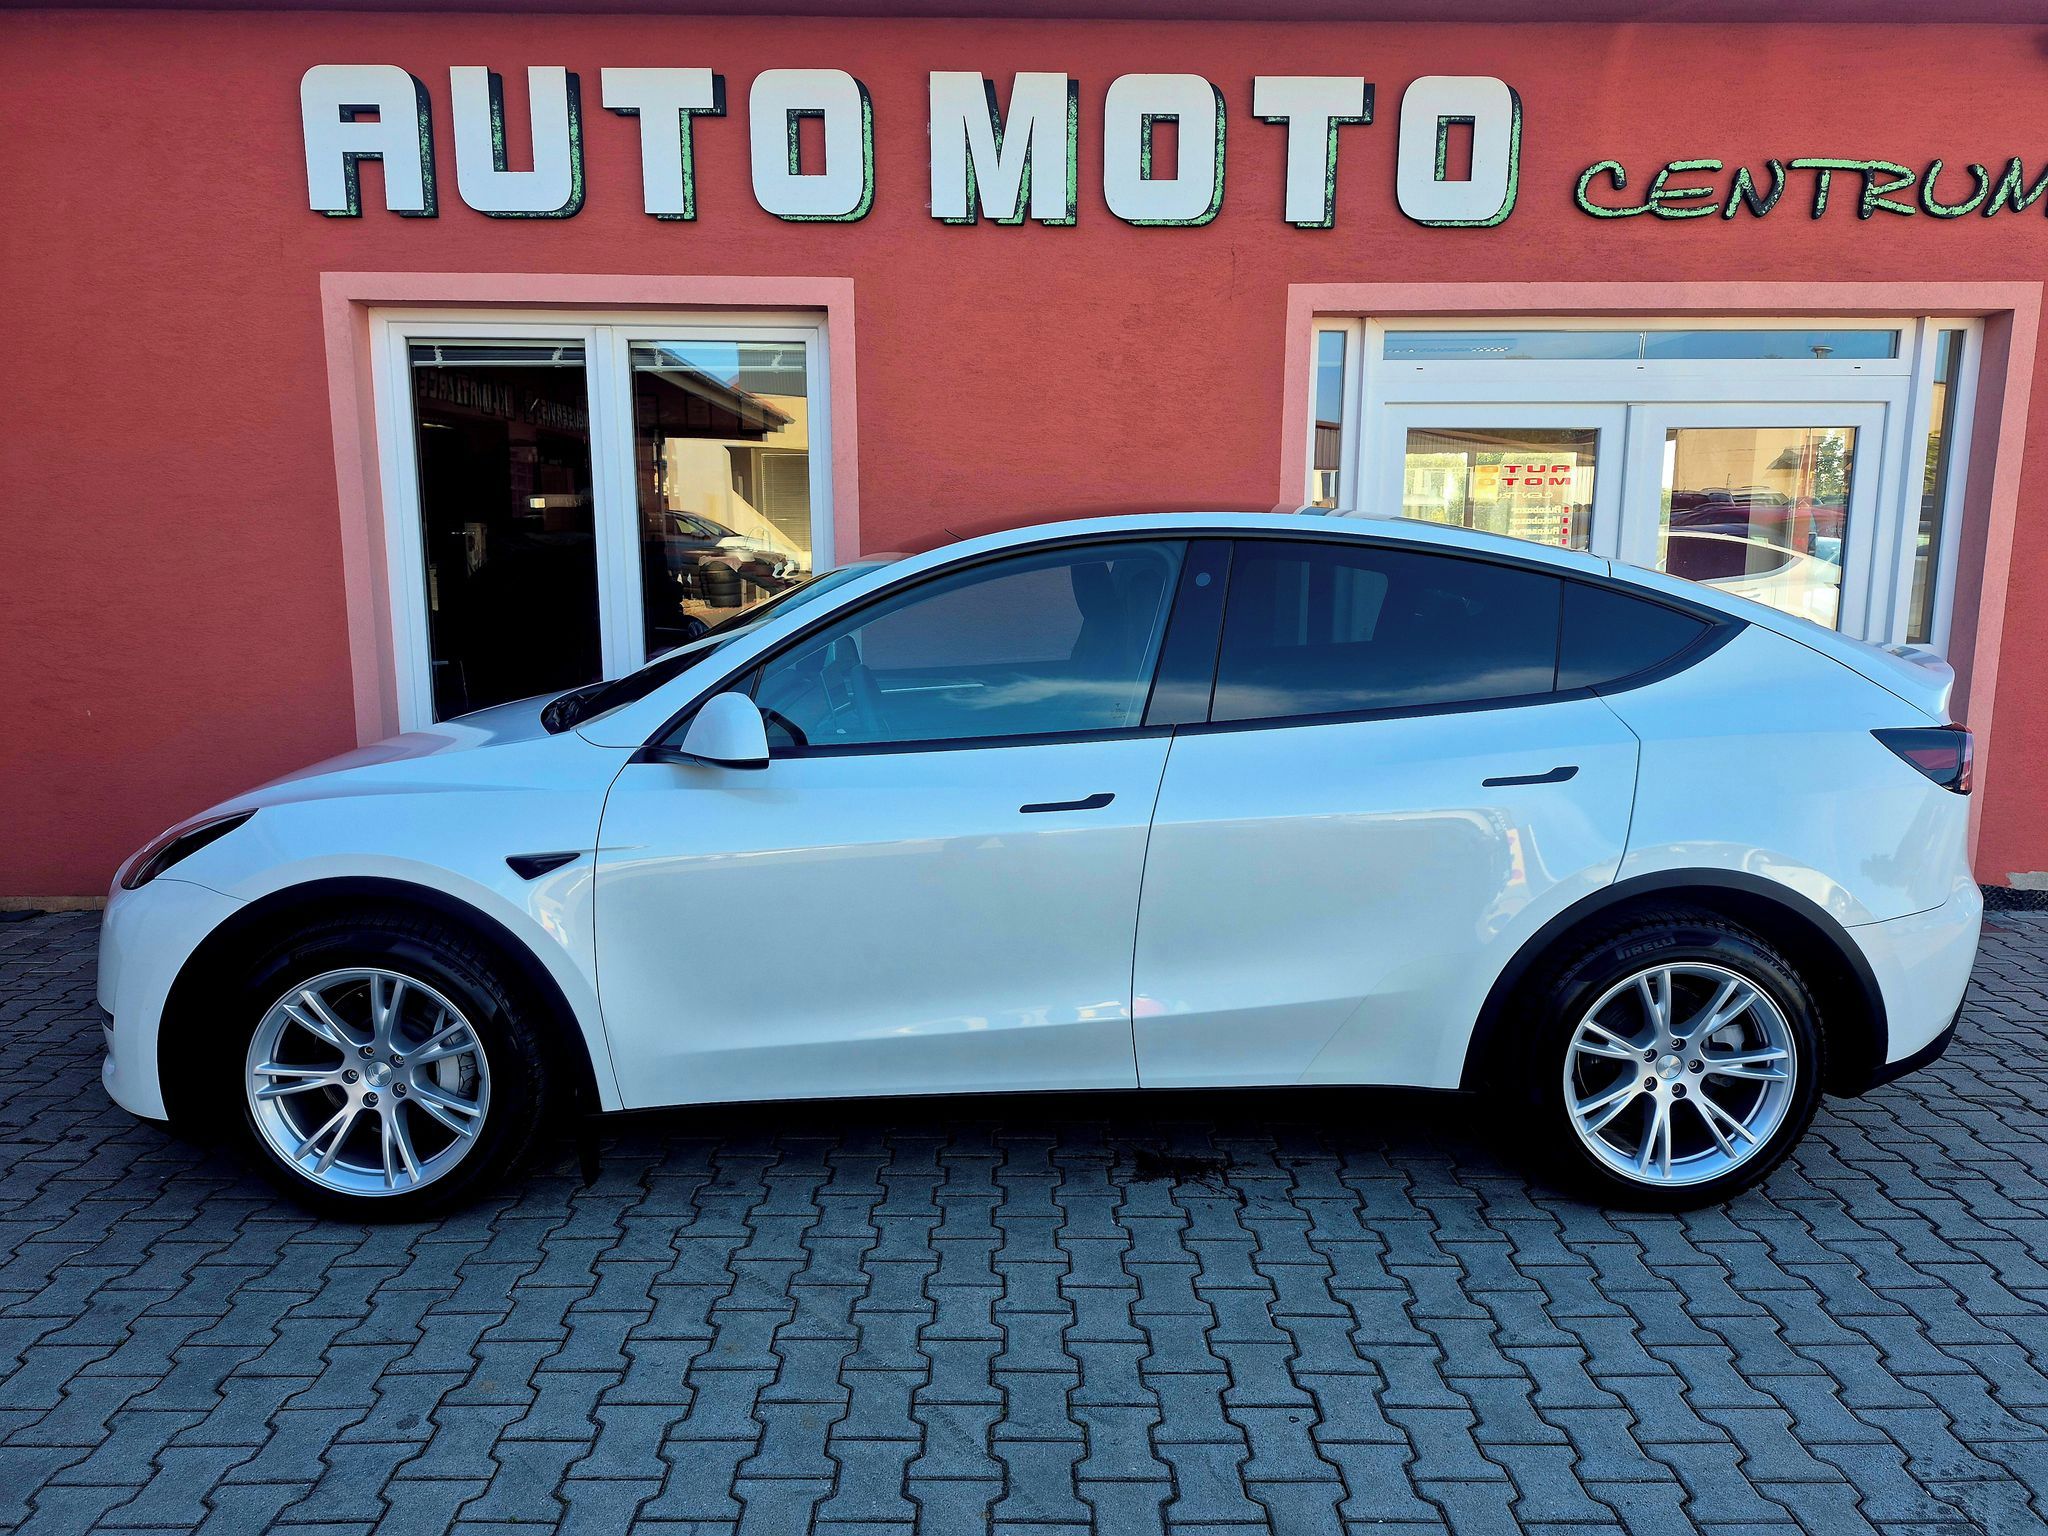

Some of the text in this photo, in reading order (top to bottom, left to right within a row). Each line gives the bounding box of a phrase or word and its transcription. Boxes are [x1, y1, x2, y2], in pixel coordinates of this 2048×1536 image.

[300, 64, 1522, 227] AUTO MOTO
[1616, 936, 1676, 961] PIRELLI
